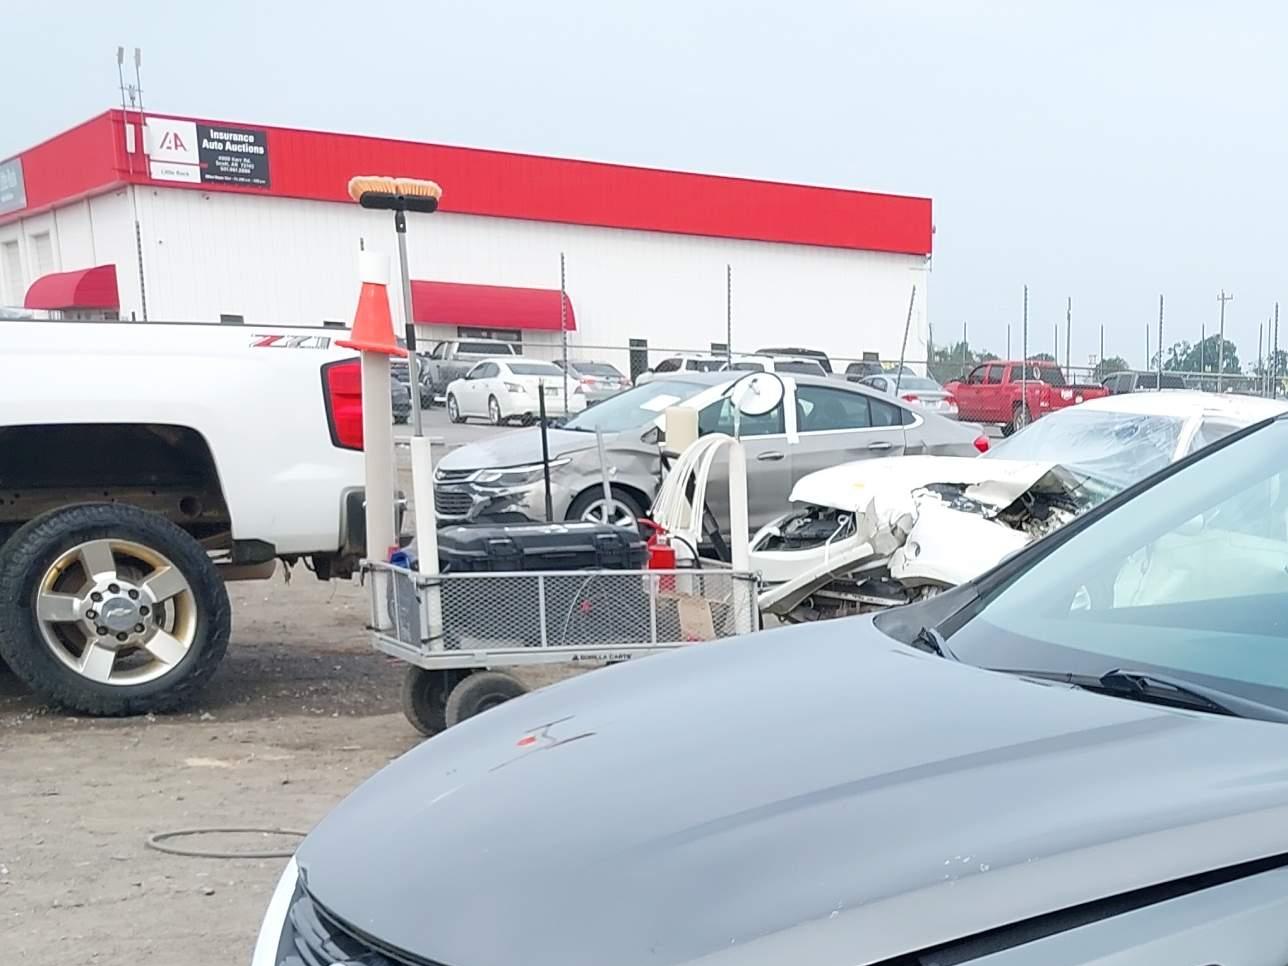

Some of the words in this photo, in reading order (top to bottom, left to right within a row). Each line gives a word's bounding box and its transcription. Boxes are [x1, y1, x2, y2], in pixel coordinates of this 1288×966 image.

[209, 128, 255, 143] Insurance
[201, 138, 224, 151] Auto
[225, 141, 265, 154] Auctions
[249, 333, 332, 350] Z71
